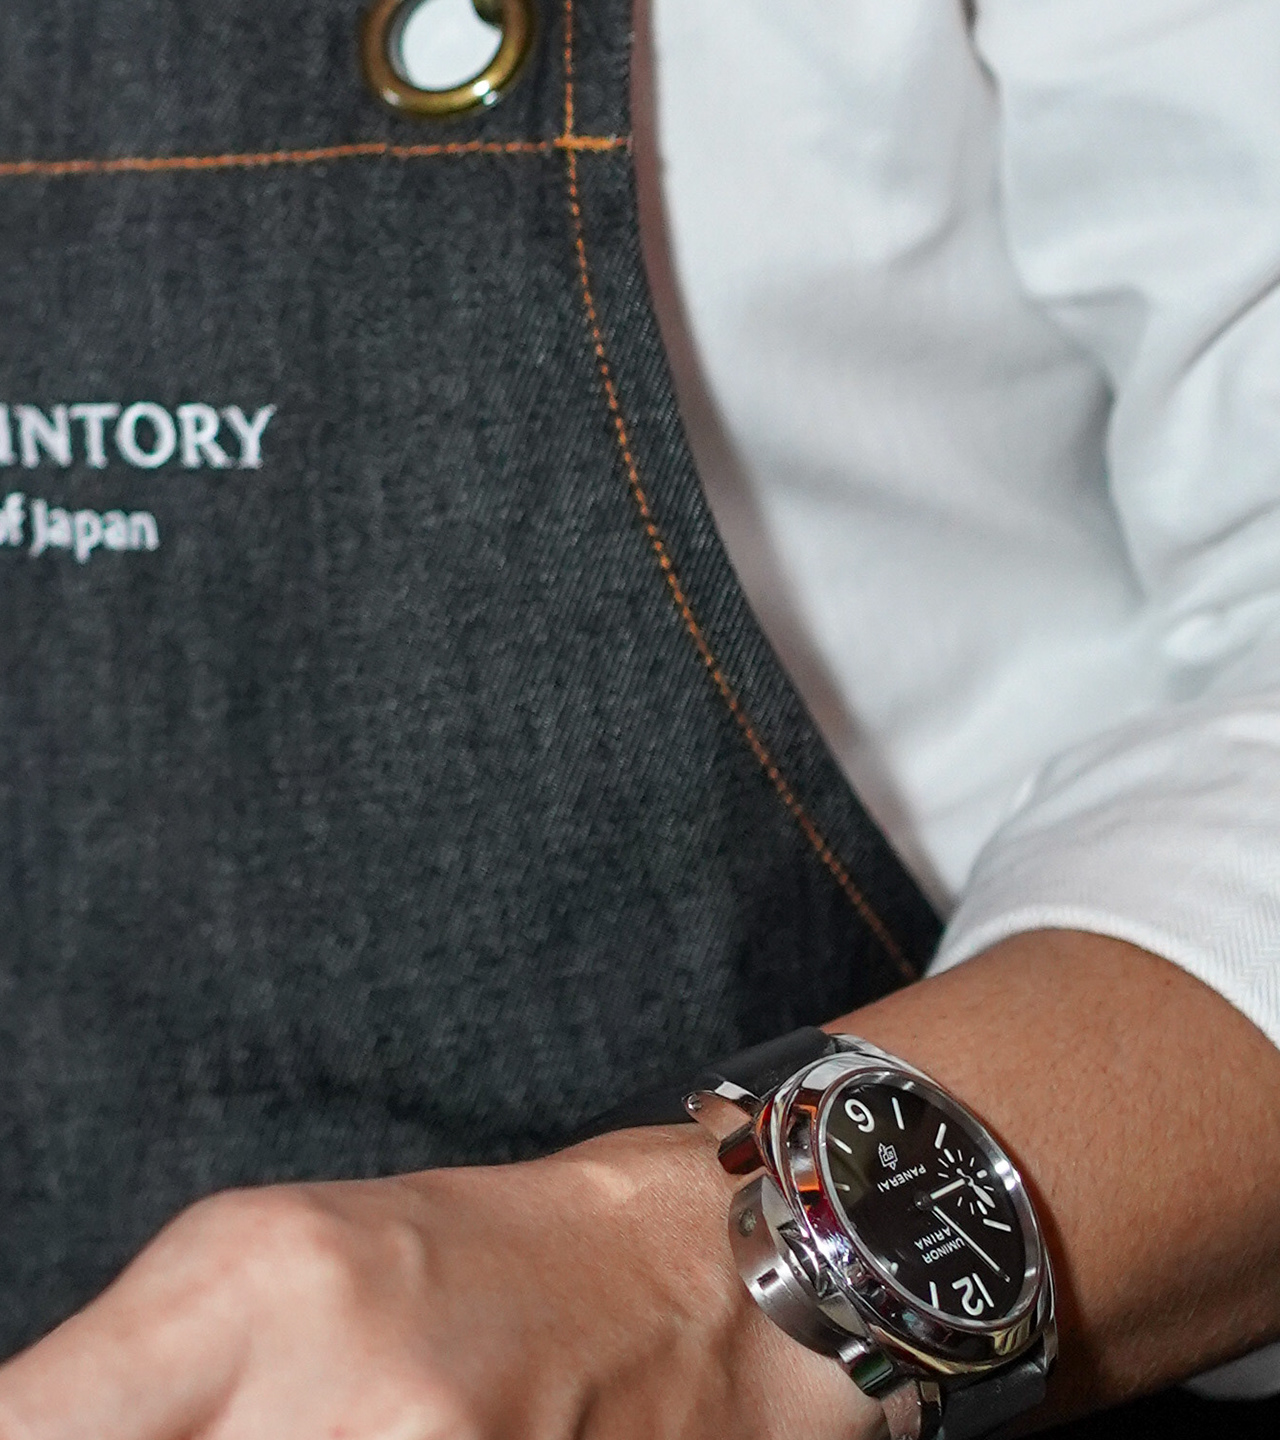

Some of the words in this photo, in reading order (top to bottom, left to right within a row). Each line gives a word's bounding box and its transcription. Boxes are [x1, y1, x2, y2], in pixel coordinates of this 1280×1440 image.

[28, 497, 160, 565] Japan
[844, 1098, 876, 1134] 6
[876, 1163, 927, 1193] PANERAI
[914, 1225, 952, 1251] ARINA
[921, 1237, 966, 1265] UMINOR
[951, 1272, 995, 1317] 12
